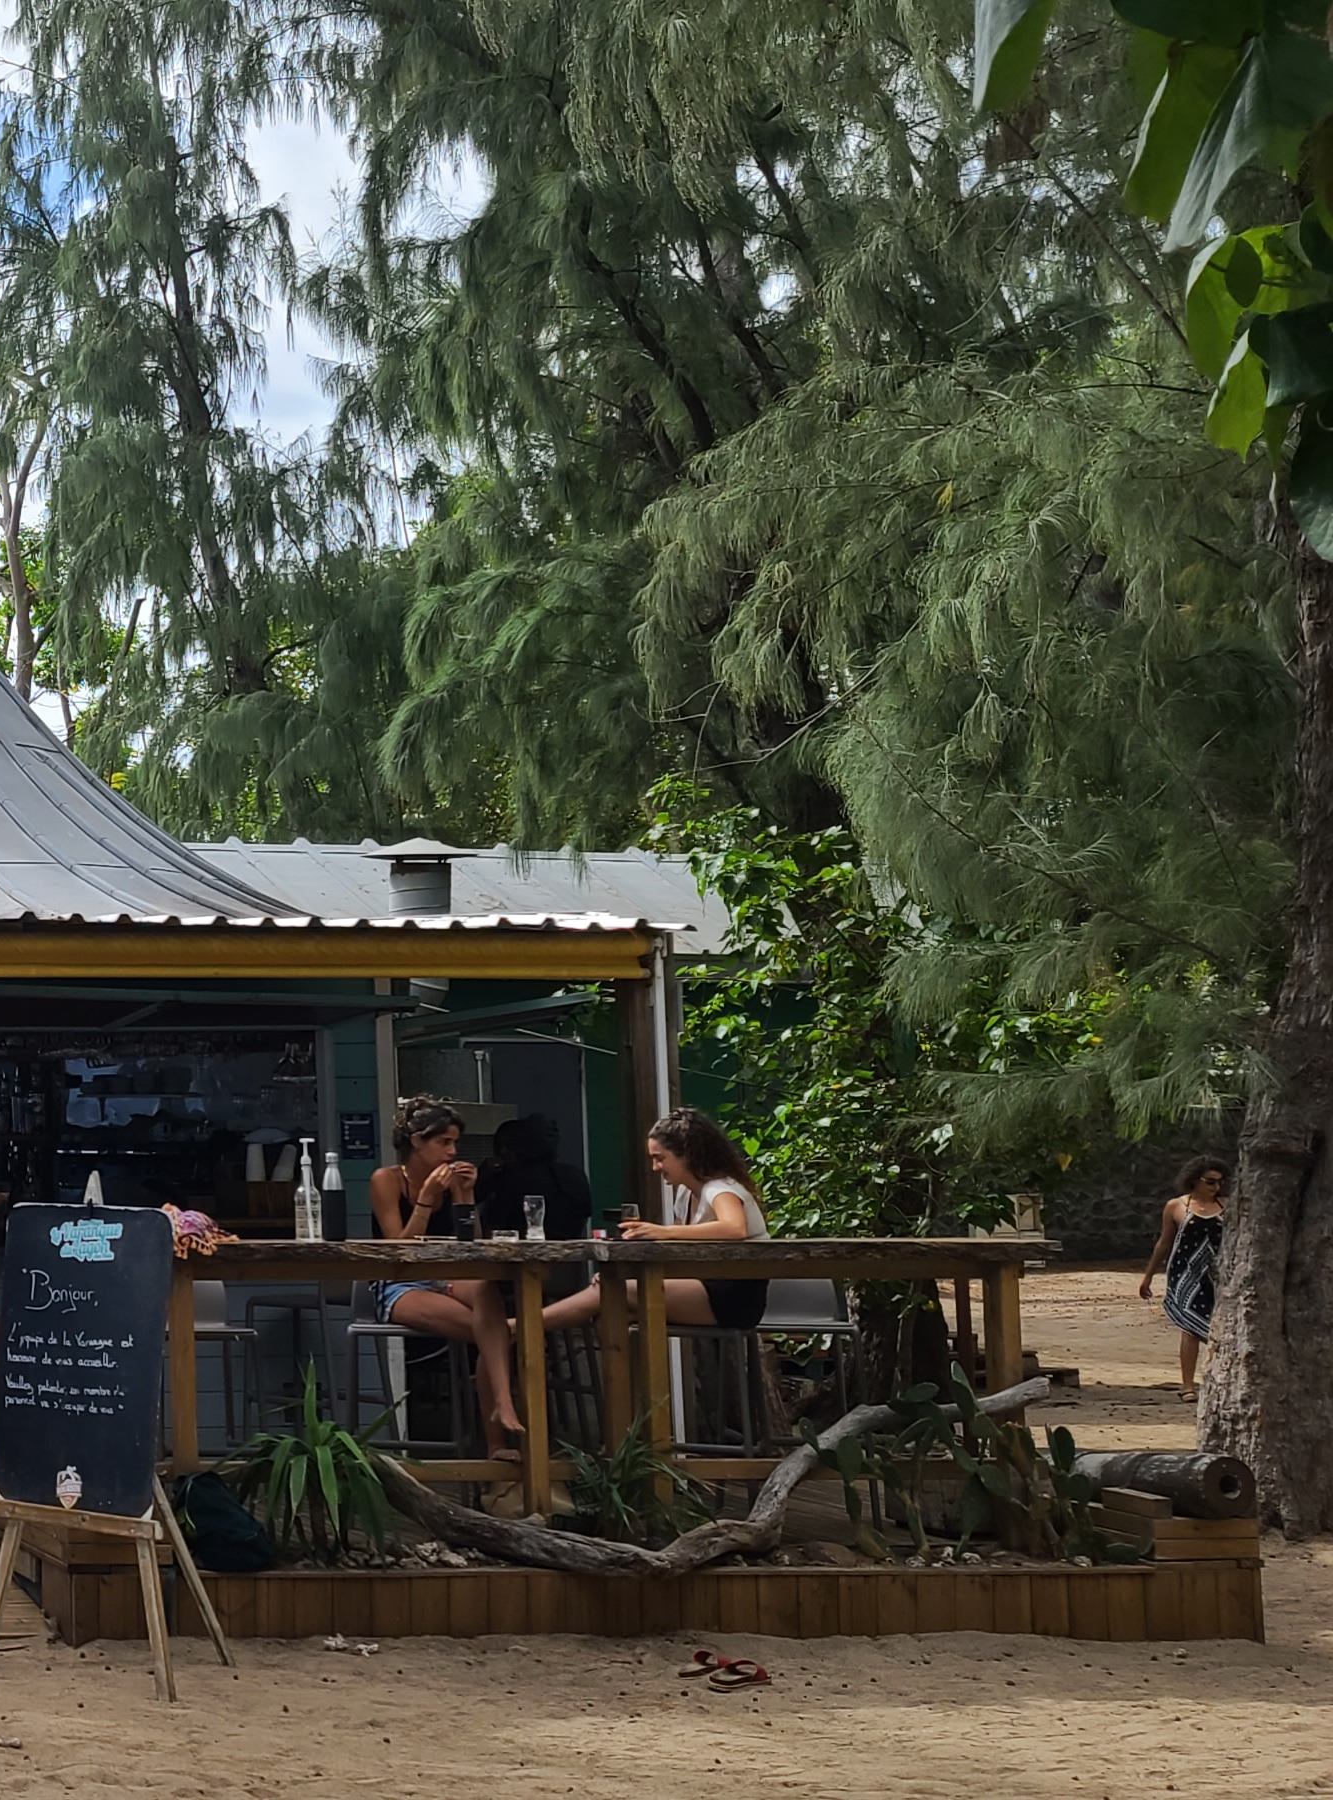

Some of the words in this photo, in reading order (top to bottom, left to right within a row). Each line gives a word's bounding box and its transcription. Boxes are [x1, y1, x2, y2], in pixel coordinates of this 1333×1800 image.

[61, 1221, 123, 1243] Varangue
[73, 1239, 110, 1262] Lagon
[47, 1330, 58, 1345] de
[63, 1330, 72, 1346] la
[41, 1351, 52, 1365] de
[88, 1400, 99, 1414] de
